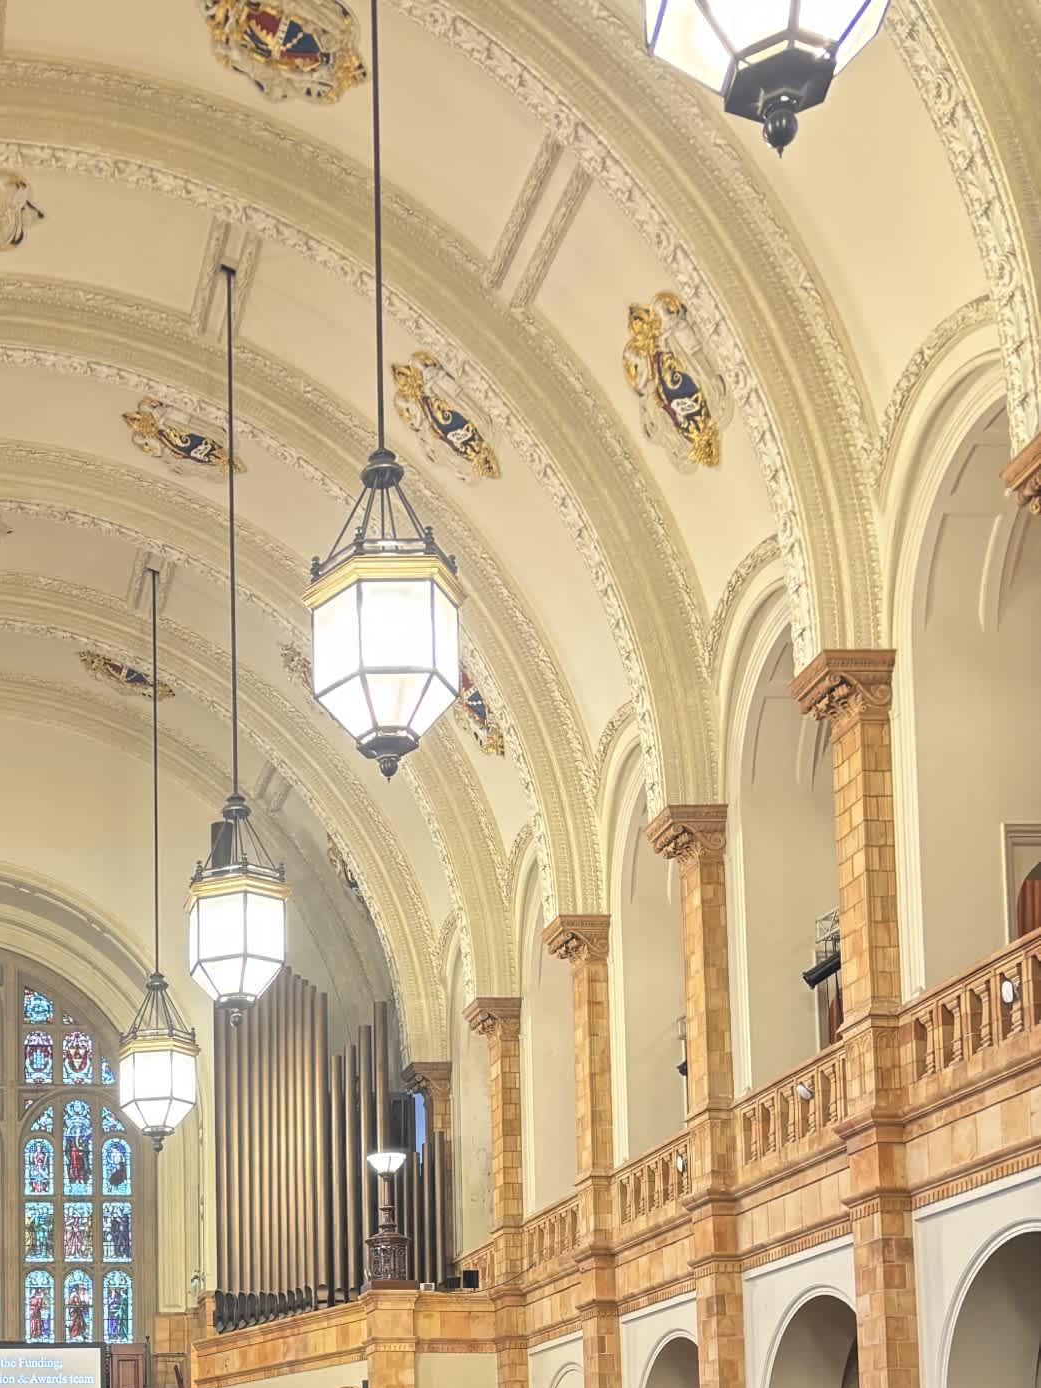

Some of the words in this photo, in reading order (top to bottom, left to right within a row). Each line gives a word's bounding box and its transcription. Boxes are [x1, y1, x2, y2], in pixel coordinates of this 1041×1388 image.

[1, 1357, 17, 1368] the
[17, 1374, 28, 1384] &
[29, 1374, 67, 1384] Awards
[69, 1375, 95, 1384] team
